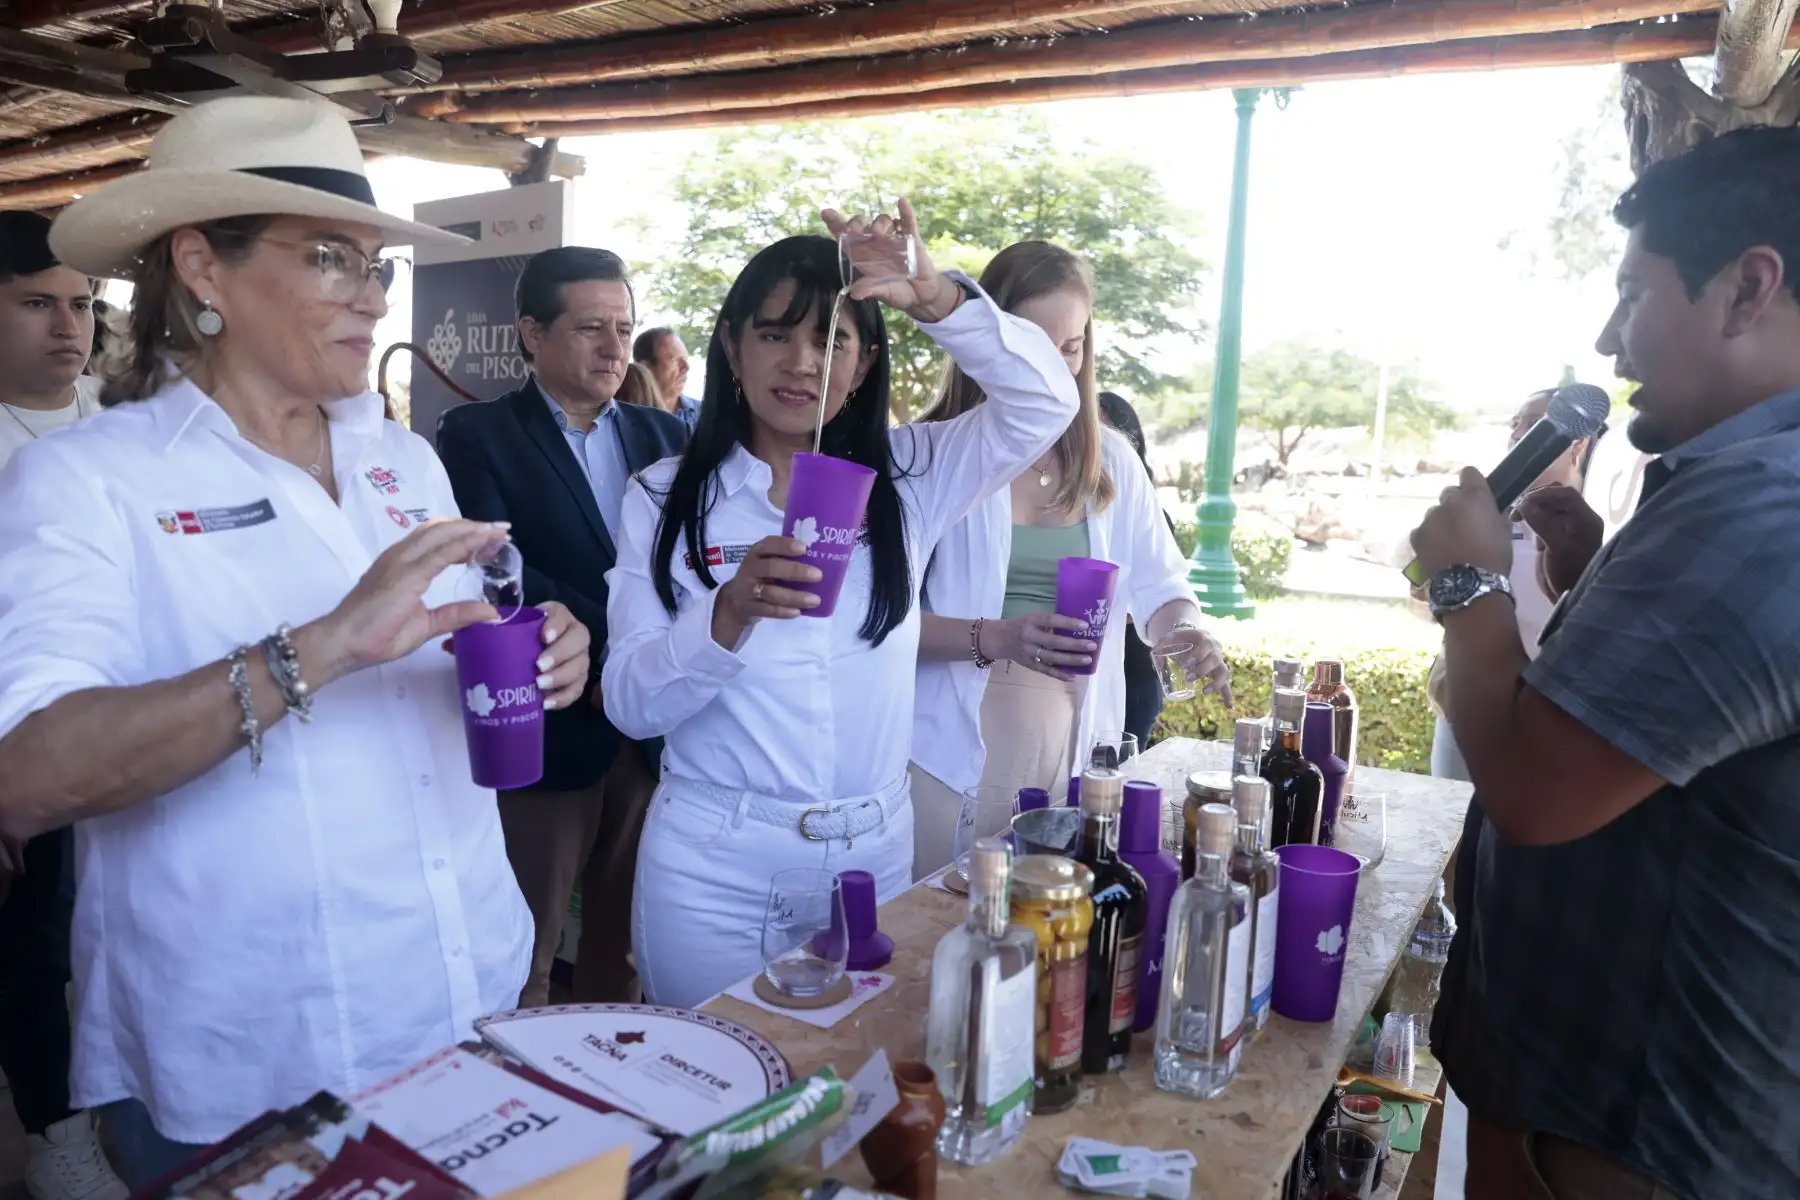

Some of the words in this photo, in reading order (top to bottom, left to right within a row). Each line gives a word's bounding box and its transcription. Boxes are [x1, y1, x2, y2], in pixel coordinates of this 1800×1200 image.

[582, 1033, 628, 1062] TACNA
[659, 1053, 732, 1092] DIRCETUR
[440, 1112, 560, 1171] Tacna
